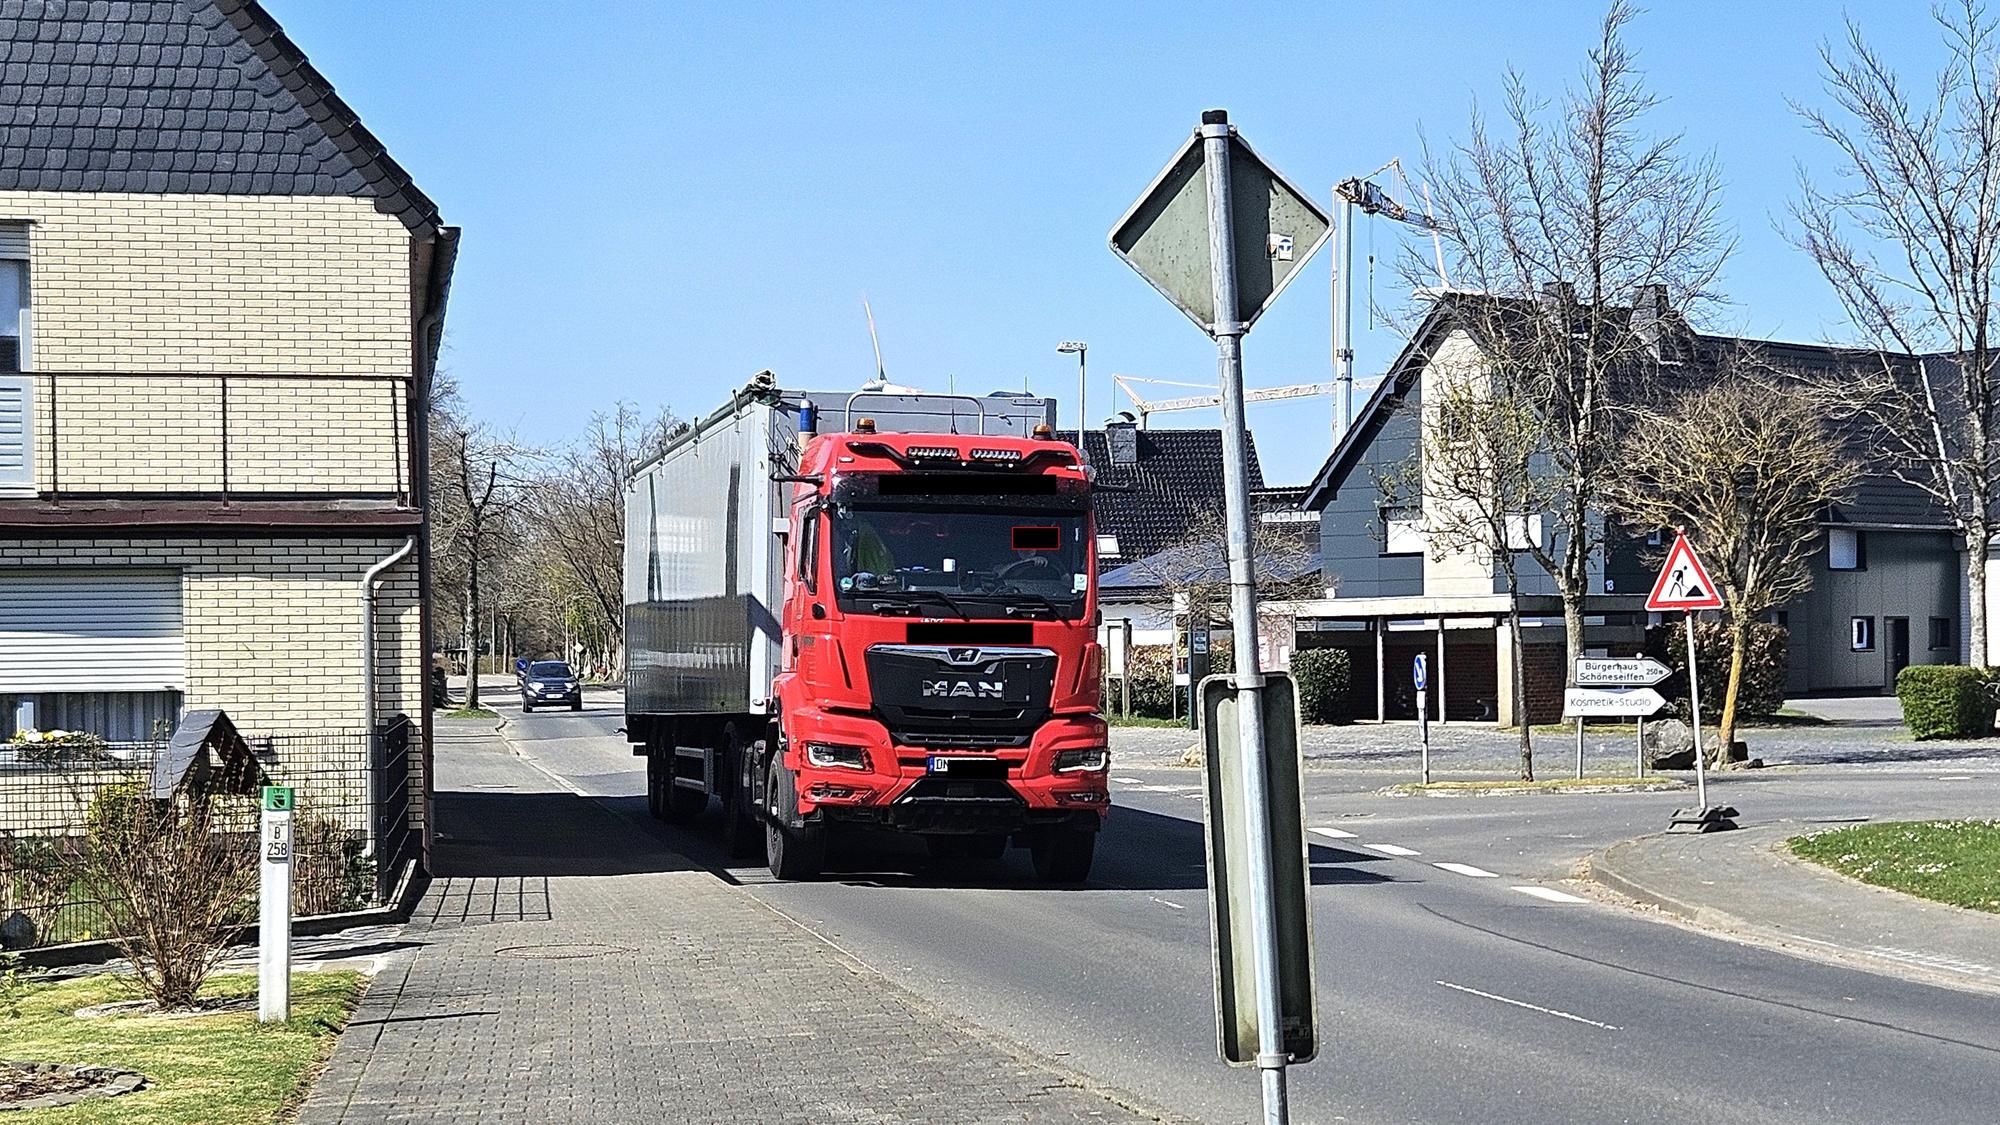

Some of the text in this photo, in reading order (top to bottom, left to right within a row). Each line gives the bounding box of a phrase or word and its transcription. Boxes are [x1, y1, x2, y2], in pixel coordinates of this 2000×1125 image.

[1585, 662, 1638, 672] Bürgerhaus
[1580, 672, 1645, 681] Schöneseiffen
[922, 680, 1003, 698] MAN
[1570, 697, 1652, 707] Kosmetik-Studio
[274, 826, 281, 840] B
[267, 842, 288, 856] 258
